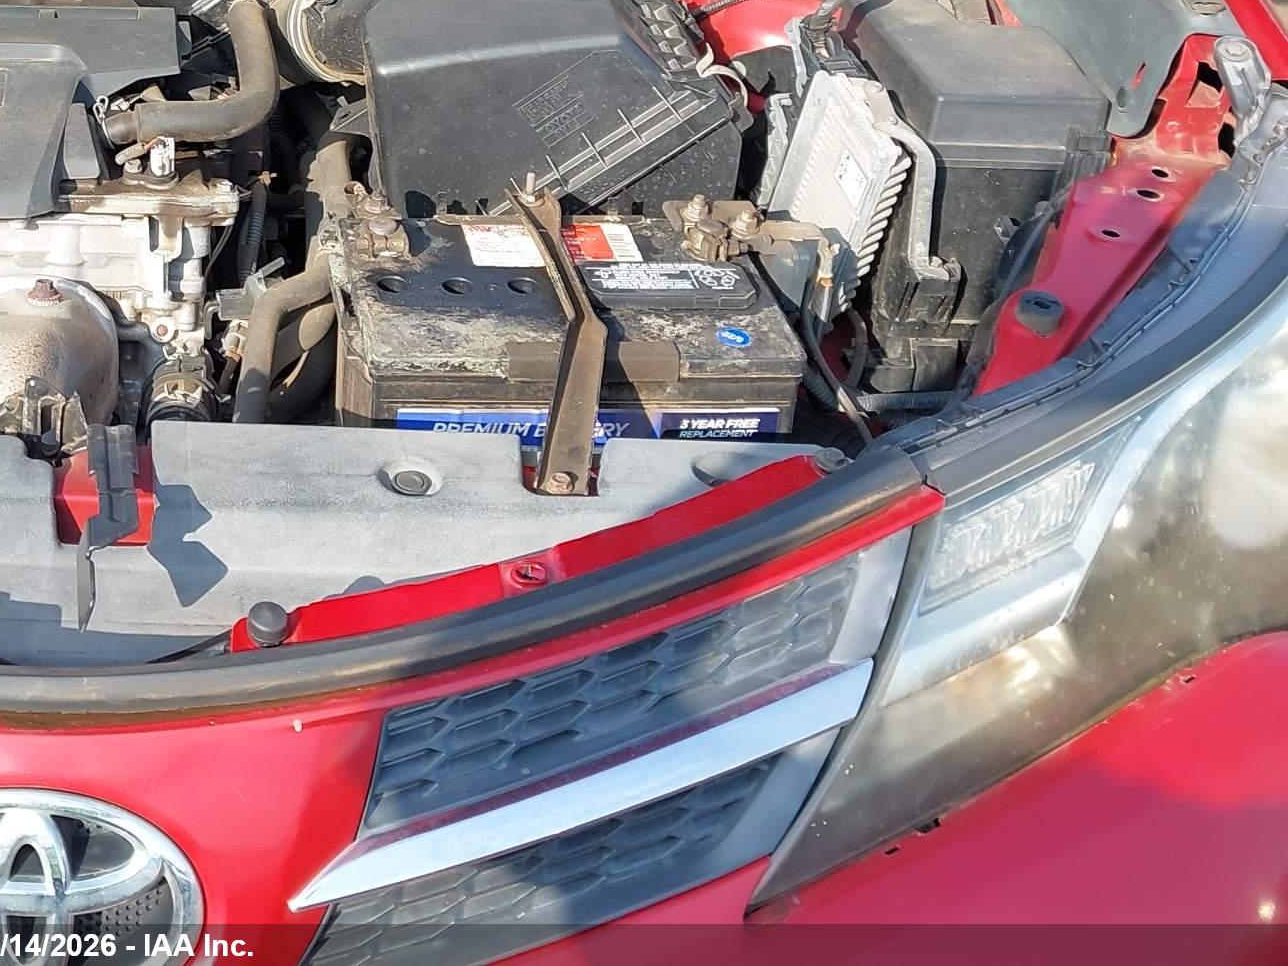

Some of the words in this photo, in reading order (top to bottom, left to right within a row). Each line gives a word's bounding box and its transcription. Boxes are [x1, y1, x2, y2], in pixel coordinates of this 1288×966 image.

[691, 419, 726, 430] YEAR
[725, 419, 761, 429] FREE
[679, 430, 759, 438] REPLACEMENT
